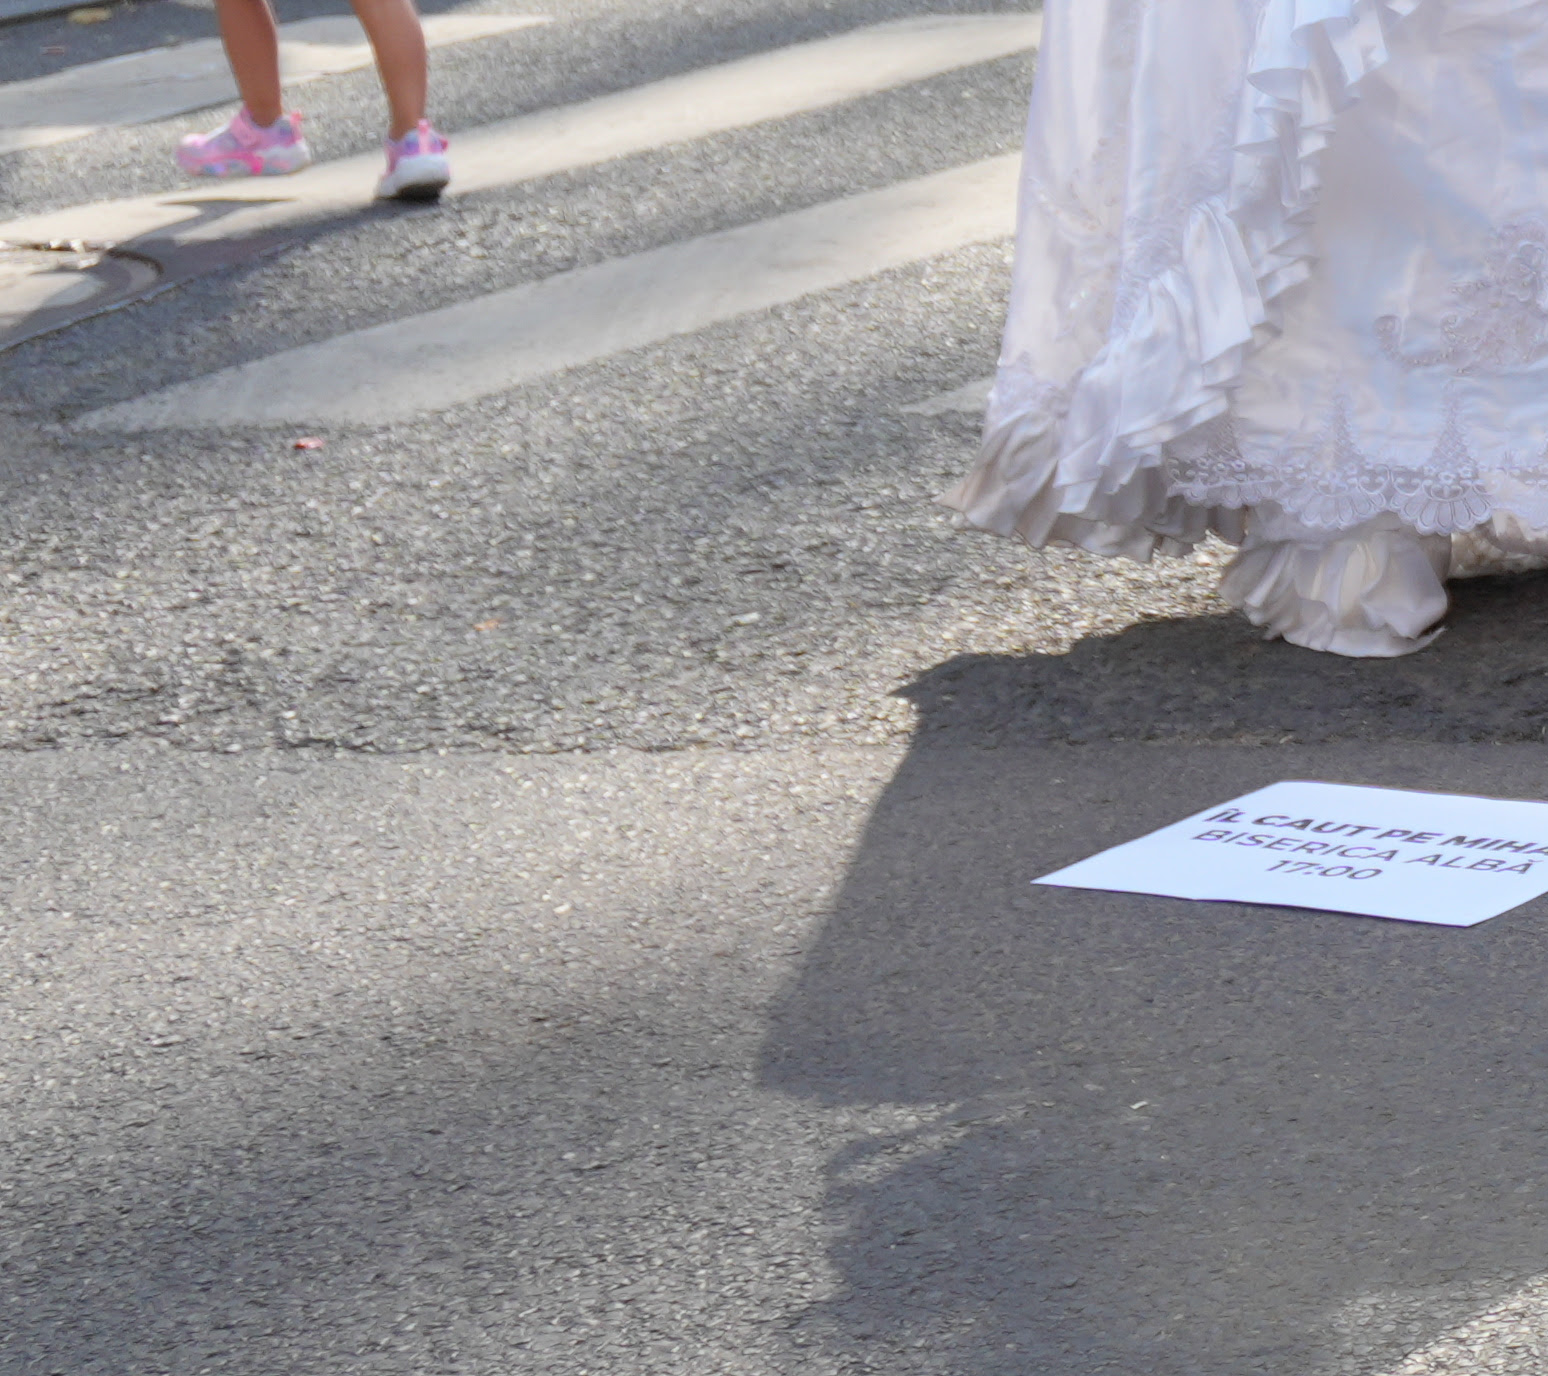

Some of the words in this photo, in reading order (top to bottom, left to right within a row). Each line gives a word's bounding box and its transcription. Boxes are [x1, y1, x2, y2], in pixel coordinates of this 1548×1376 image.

[1202, 807, 1243, 824] ÎL
[1251, 814, 1379, 838] CAUT
[1373, 828, 1444, 845] PE
[1191, 829, 1401, 862] BISERICA
[1403, 853, 1539, 876] ALBĂ
[1265, 859, 1385, 881] 17:00
